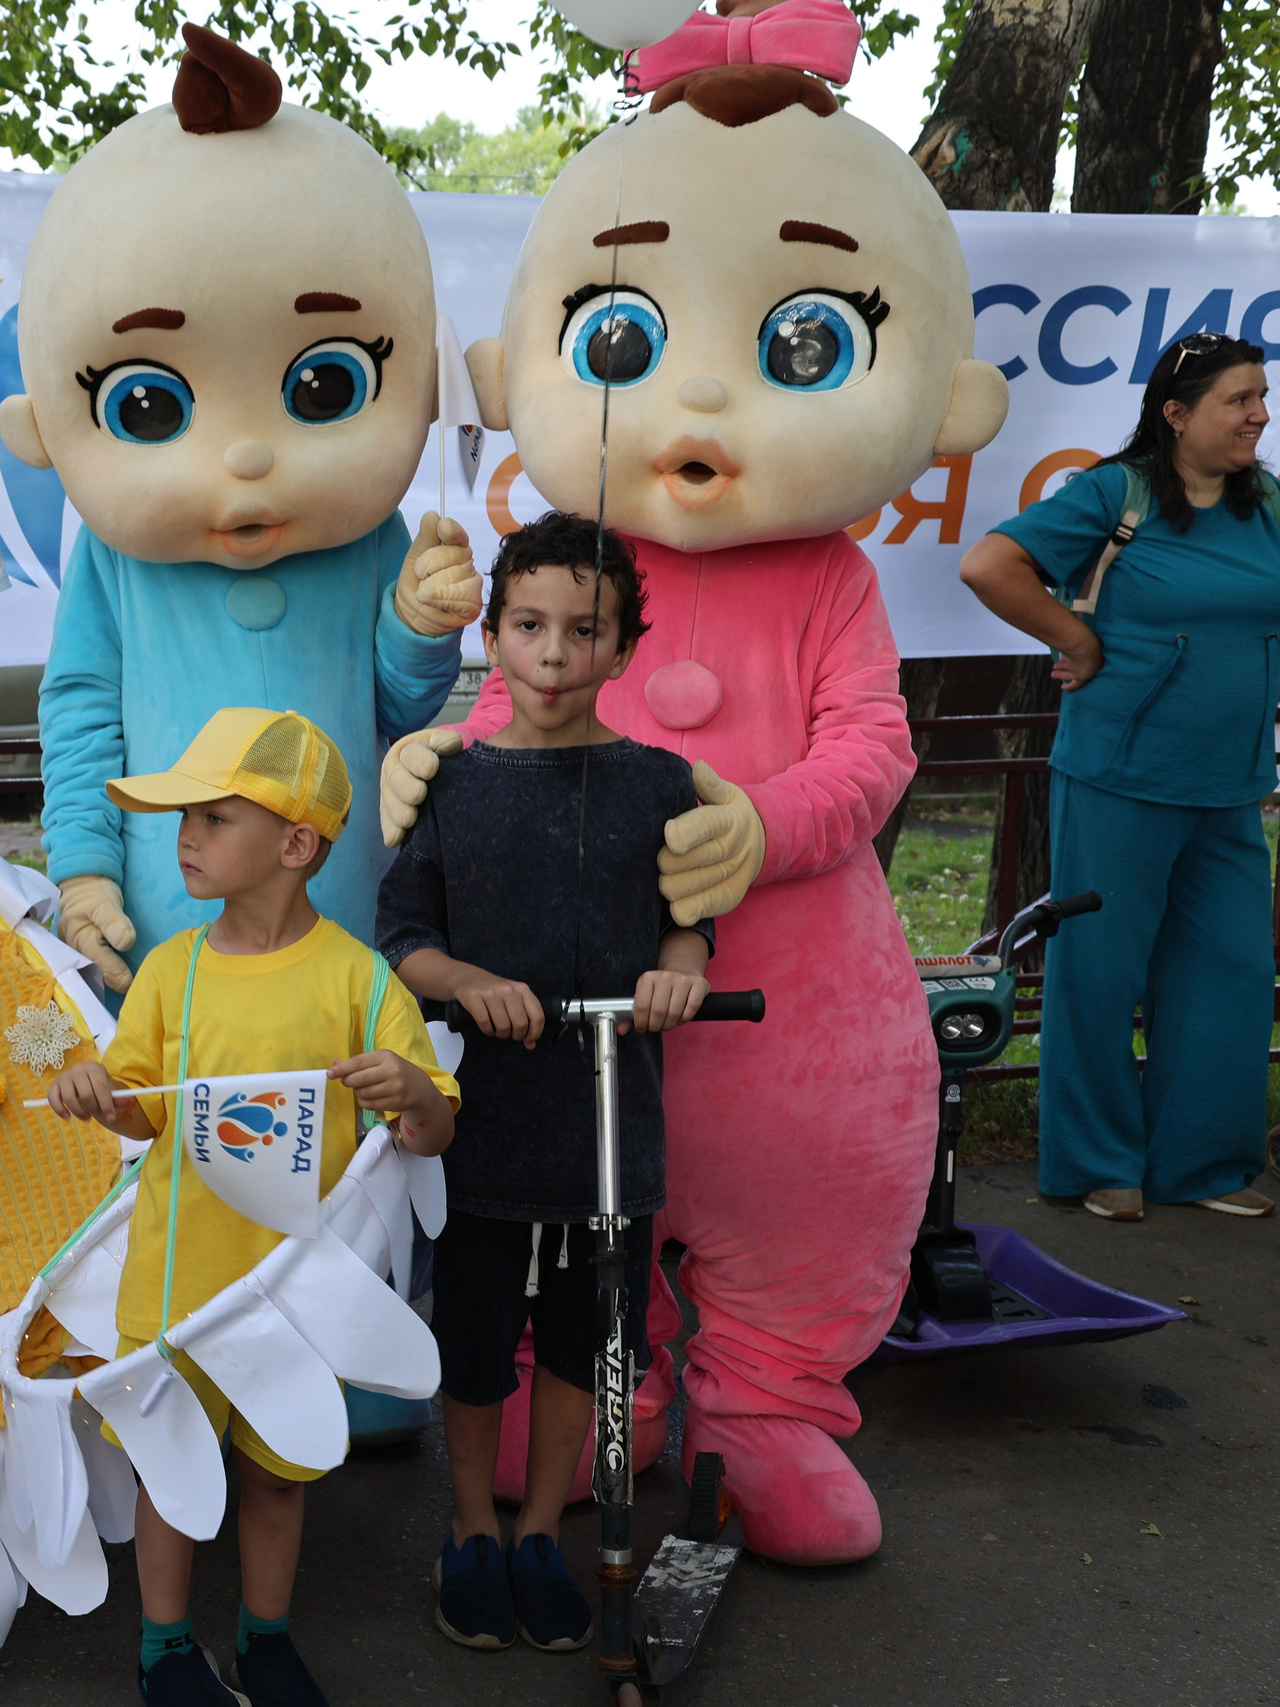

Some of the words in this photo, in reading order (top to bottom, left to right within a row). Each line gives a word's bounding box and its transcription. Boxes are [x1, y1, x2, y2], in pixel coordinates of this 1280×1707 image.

[915, 957, 972, 967] АШАЛОТ
[193, 1082, 212, 1164] СЕМЬИ
[291, 1087, 316, 1174] ПАРАД
